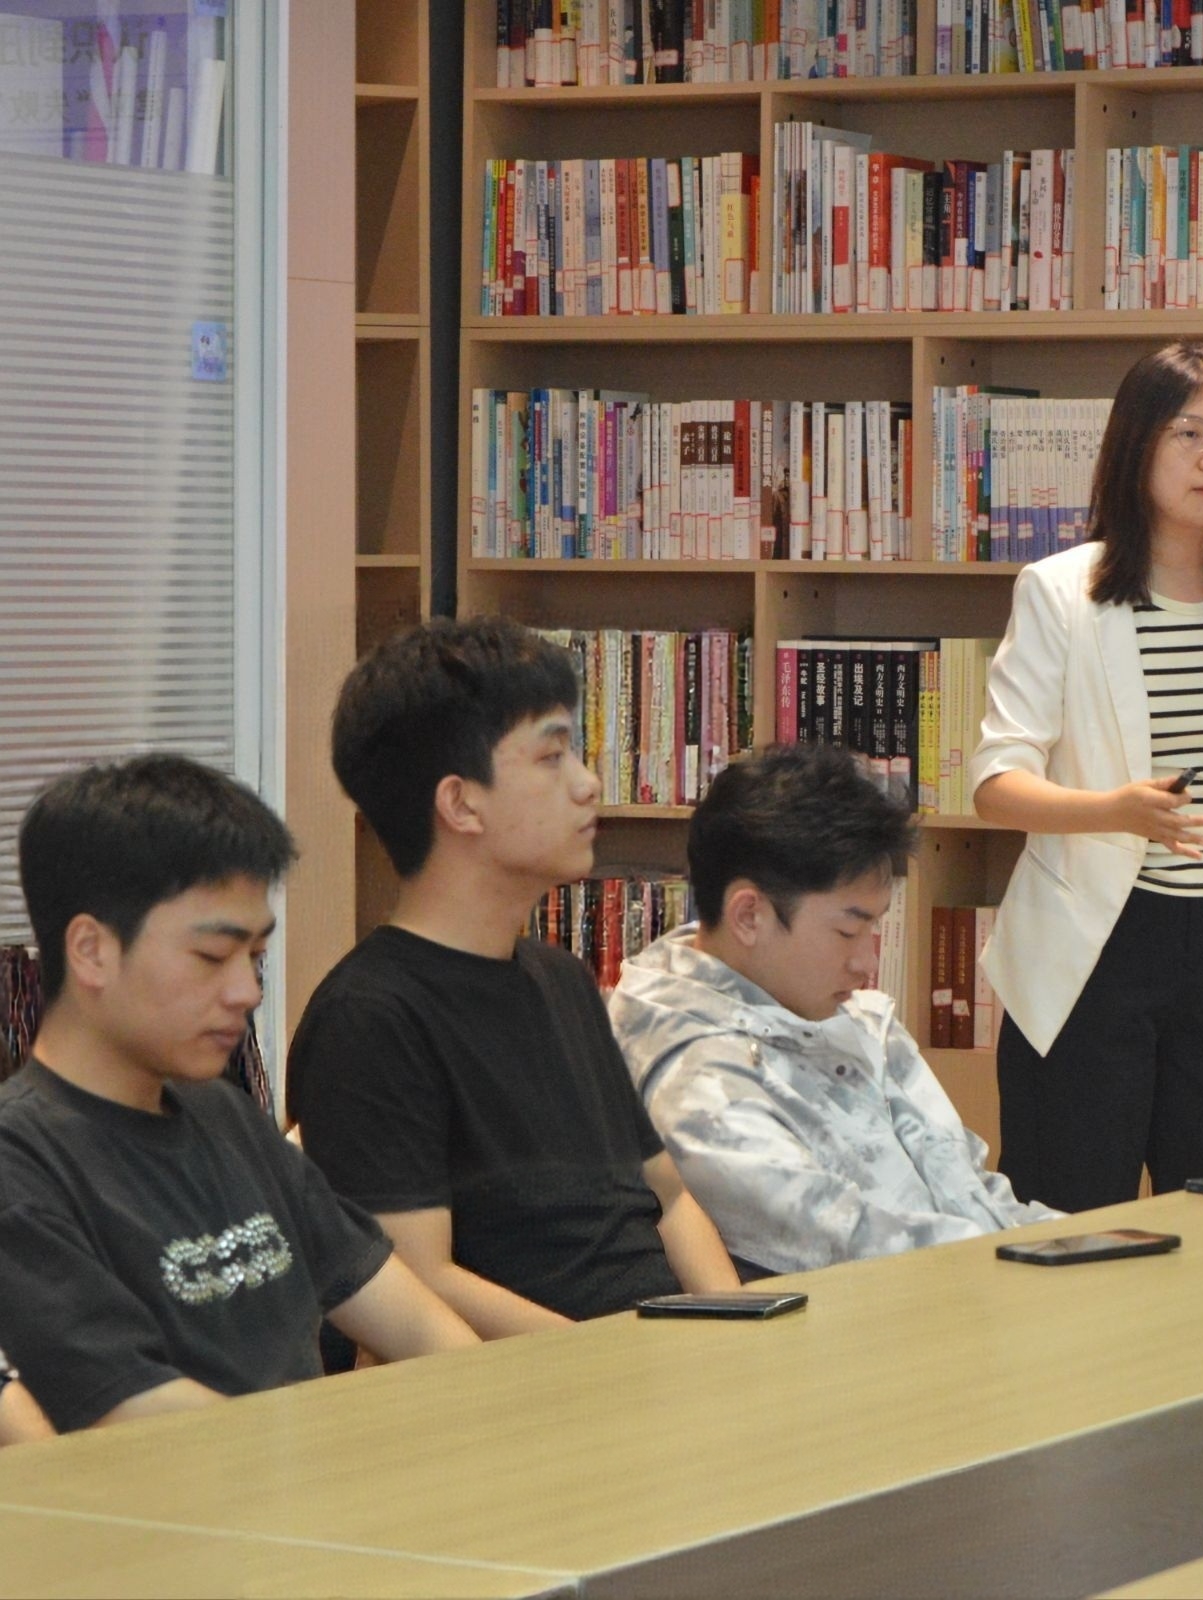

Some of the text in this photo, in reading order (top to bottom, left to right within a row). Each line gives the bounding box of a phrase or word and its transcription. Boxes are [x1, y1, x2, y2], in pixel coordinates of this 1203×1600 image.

[781, 662, 791, 708] 毛泽东传
[815, 662, 826, 706] 圣经故事
[853, 663, 864, 706] 出埃及记
[875, 663, 885, 707] 西方文明史
[896, 663, 906, 707] 西方文明史
